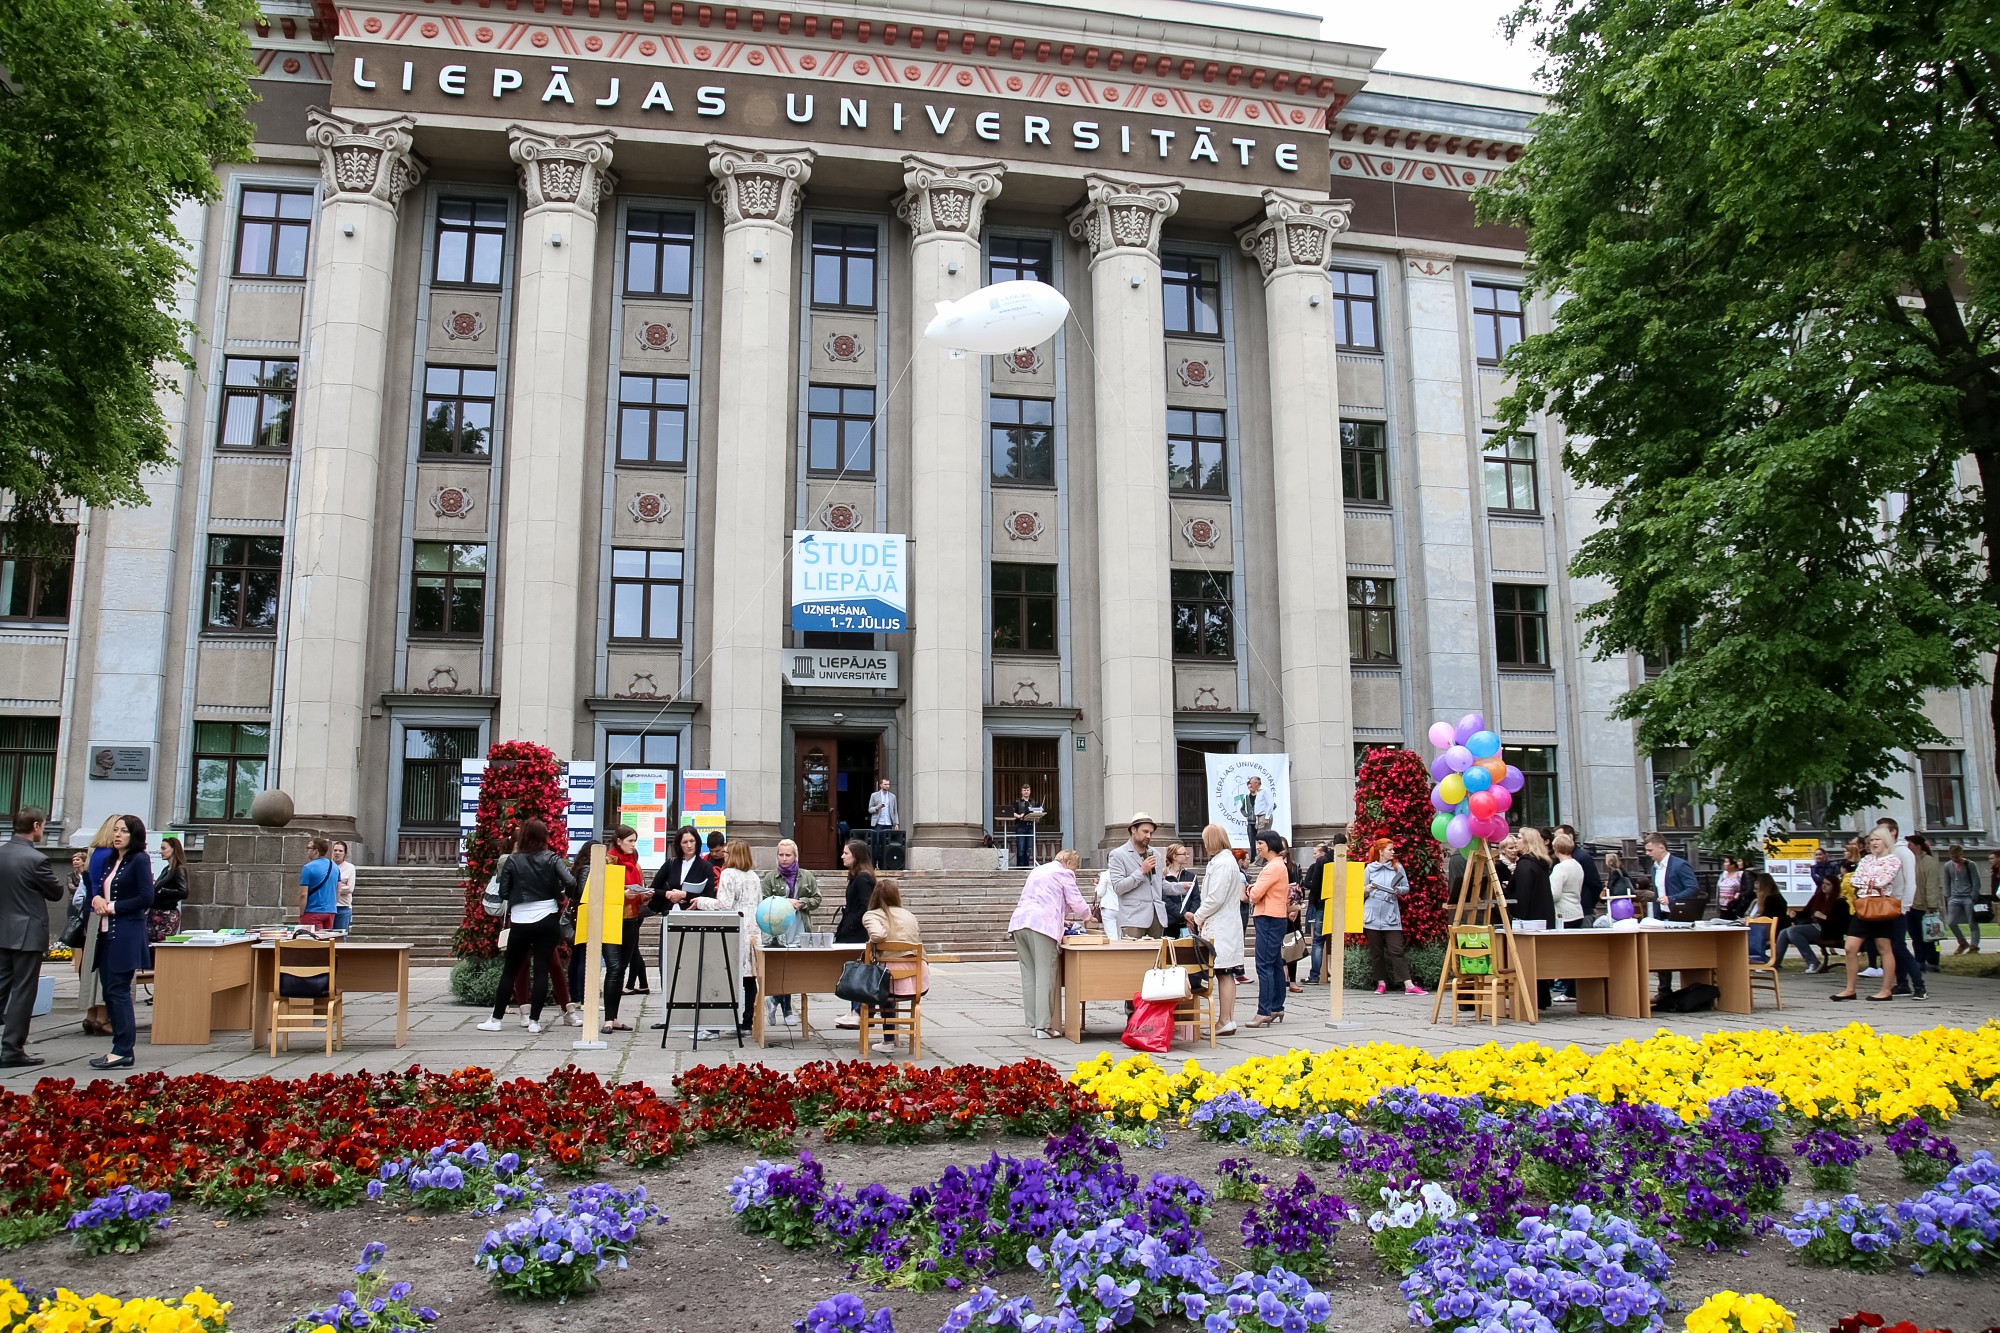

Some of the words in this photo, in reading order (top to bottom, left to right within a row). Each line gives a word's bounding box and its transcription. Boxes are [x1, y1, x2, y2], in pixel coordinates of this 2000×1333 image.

[353, 57, 727, 116] LIEPĀJAS
[785, 93, 1299, 171] UNIVERSITĀTE
[804, 540, 898, 567] STUDĒ
[804, 569, 898, 593] LIEPĀJĀ
[802, 603, 868, 617] UZŅEMŠANA
[830, 617, 855, 629] 1.-7.
[857, 616, 901, 630] JŪLIJS
[819, 656, 887, 669] LIEPĀJAS
[819, 671, 887, 681] UNIVERSITĀTE
